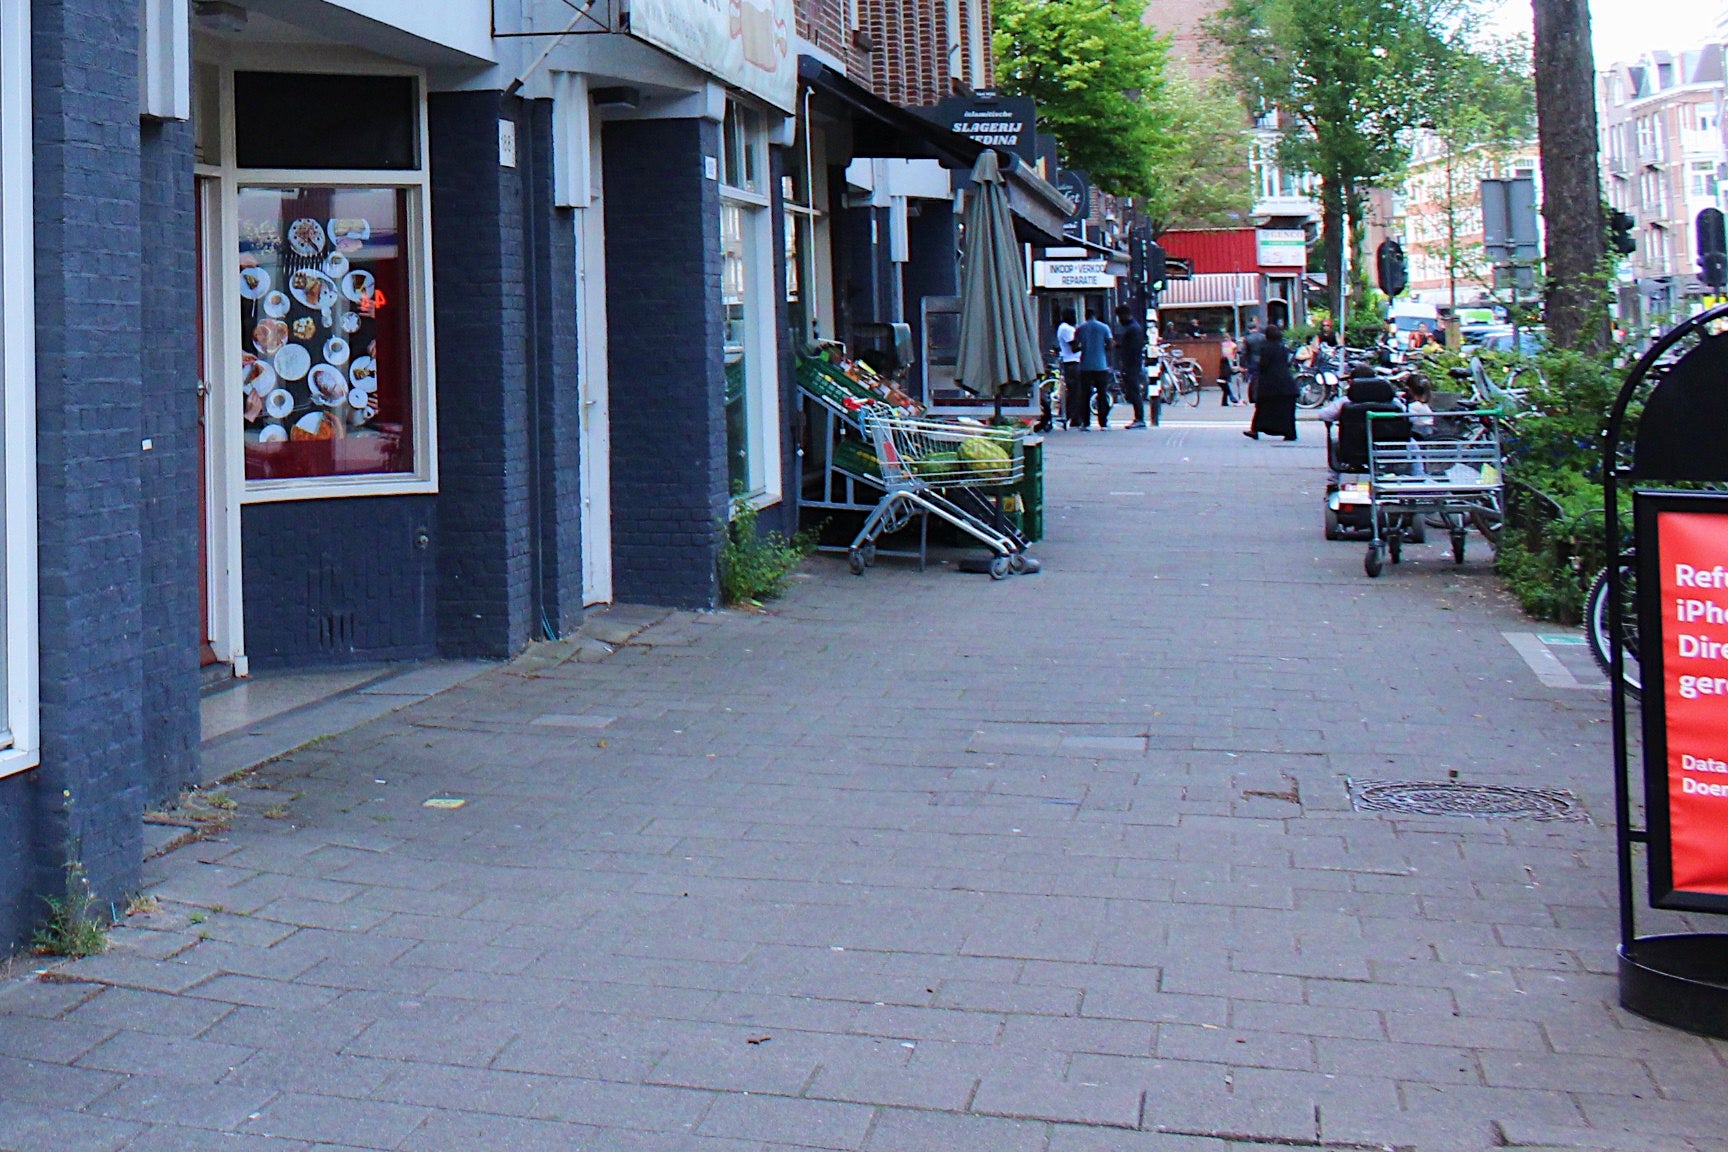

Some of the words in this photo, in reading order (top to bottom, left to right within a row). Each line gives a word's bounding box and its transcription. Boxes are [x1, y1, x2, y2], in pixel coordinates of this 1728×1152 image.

[951, 122, 1023, 133] SLAGERIJ
[1077, 264, 1106, 274] VERKOO
[1061, 275, 1098, 285] REPARATIE
[1676, 598, 1728, 625] iPh
[1678, 674, 1728, 699] ger
